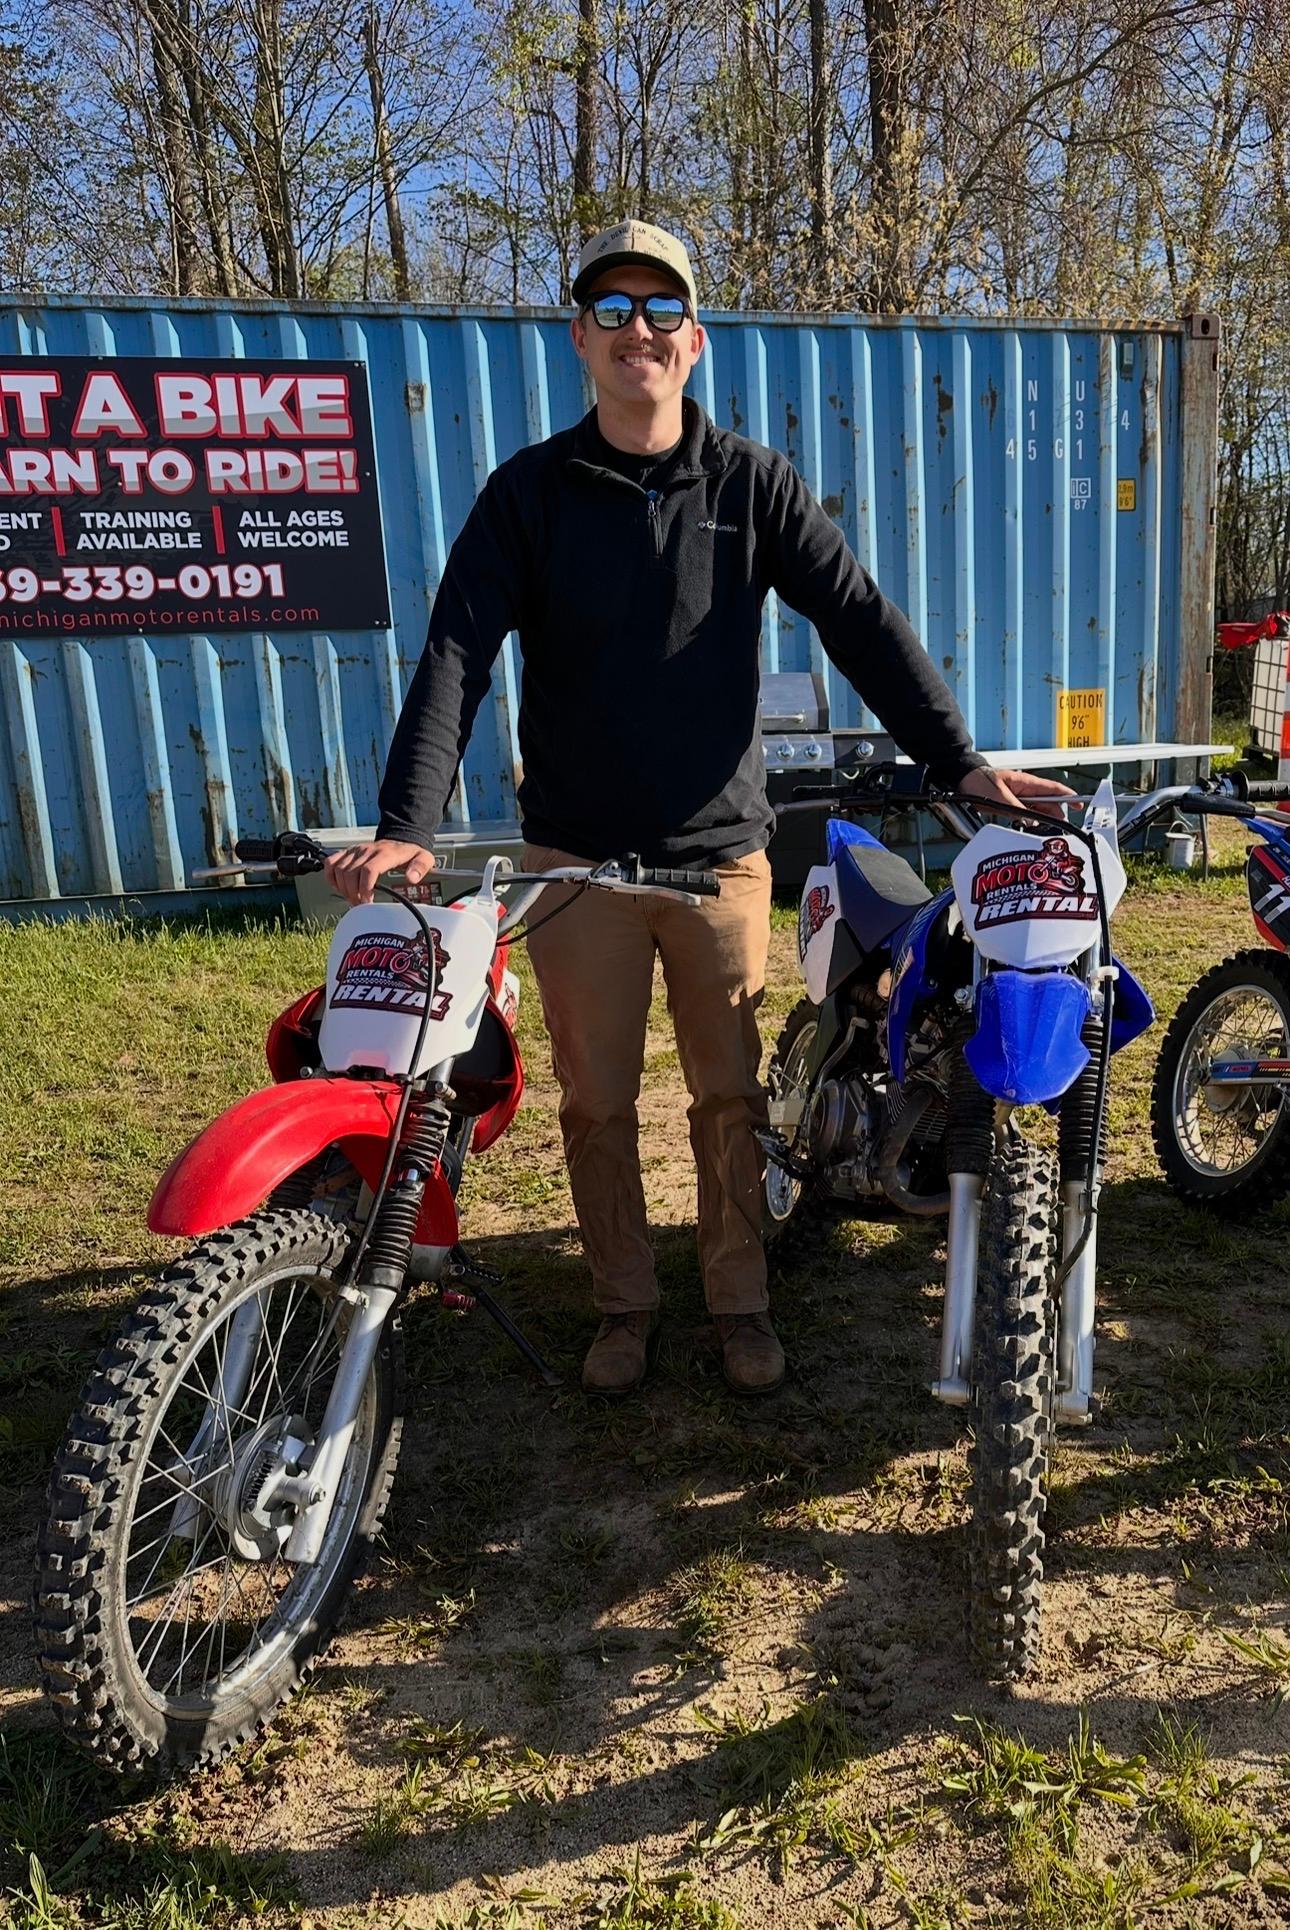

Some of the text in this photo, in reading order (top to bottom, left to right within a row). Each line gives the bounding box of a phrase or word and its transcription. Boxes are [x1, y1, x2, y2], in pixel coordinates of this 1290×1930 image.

[0, 373, 352, 436] T A BIKE
[108, 449, 194, 493] TO
[206, 449, 359, 492] RIDE!
[1074, 499, 1087, 510] 87
[80, 511, 192, 529] TRAINING
[239, 511, 344, 528] ALL AGES
[76, 532, 202, 550] AVAILABLE
[237, 531, 349, 548] WELCOME
[0, 564, 285, 602] 9-339-0191
[1059, 694, 1103, 710] CAUTION
[1067, 736, 1090, 748] HIGH
[983, 854, 1035, 873] MICHIGAN
[976, 863, 1049, 899] MOTO
[986, 883, 1038, 900] RENTALS
[978, 896, 1095, 922] RENTAL
[355, 936, 405, 949] MICHIGAN
[341, 946, 412, 973] MOTO
[346, 968, 394, 980] RENTALS
[333, 984, 448, 1013] RENTAL
